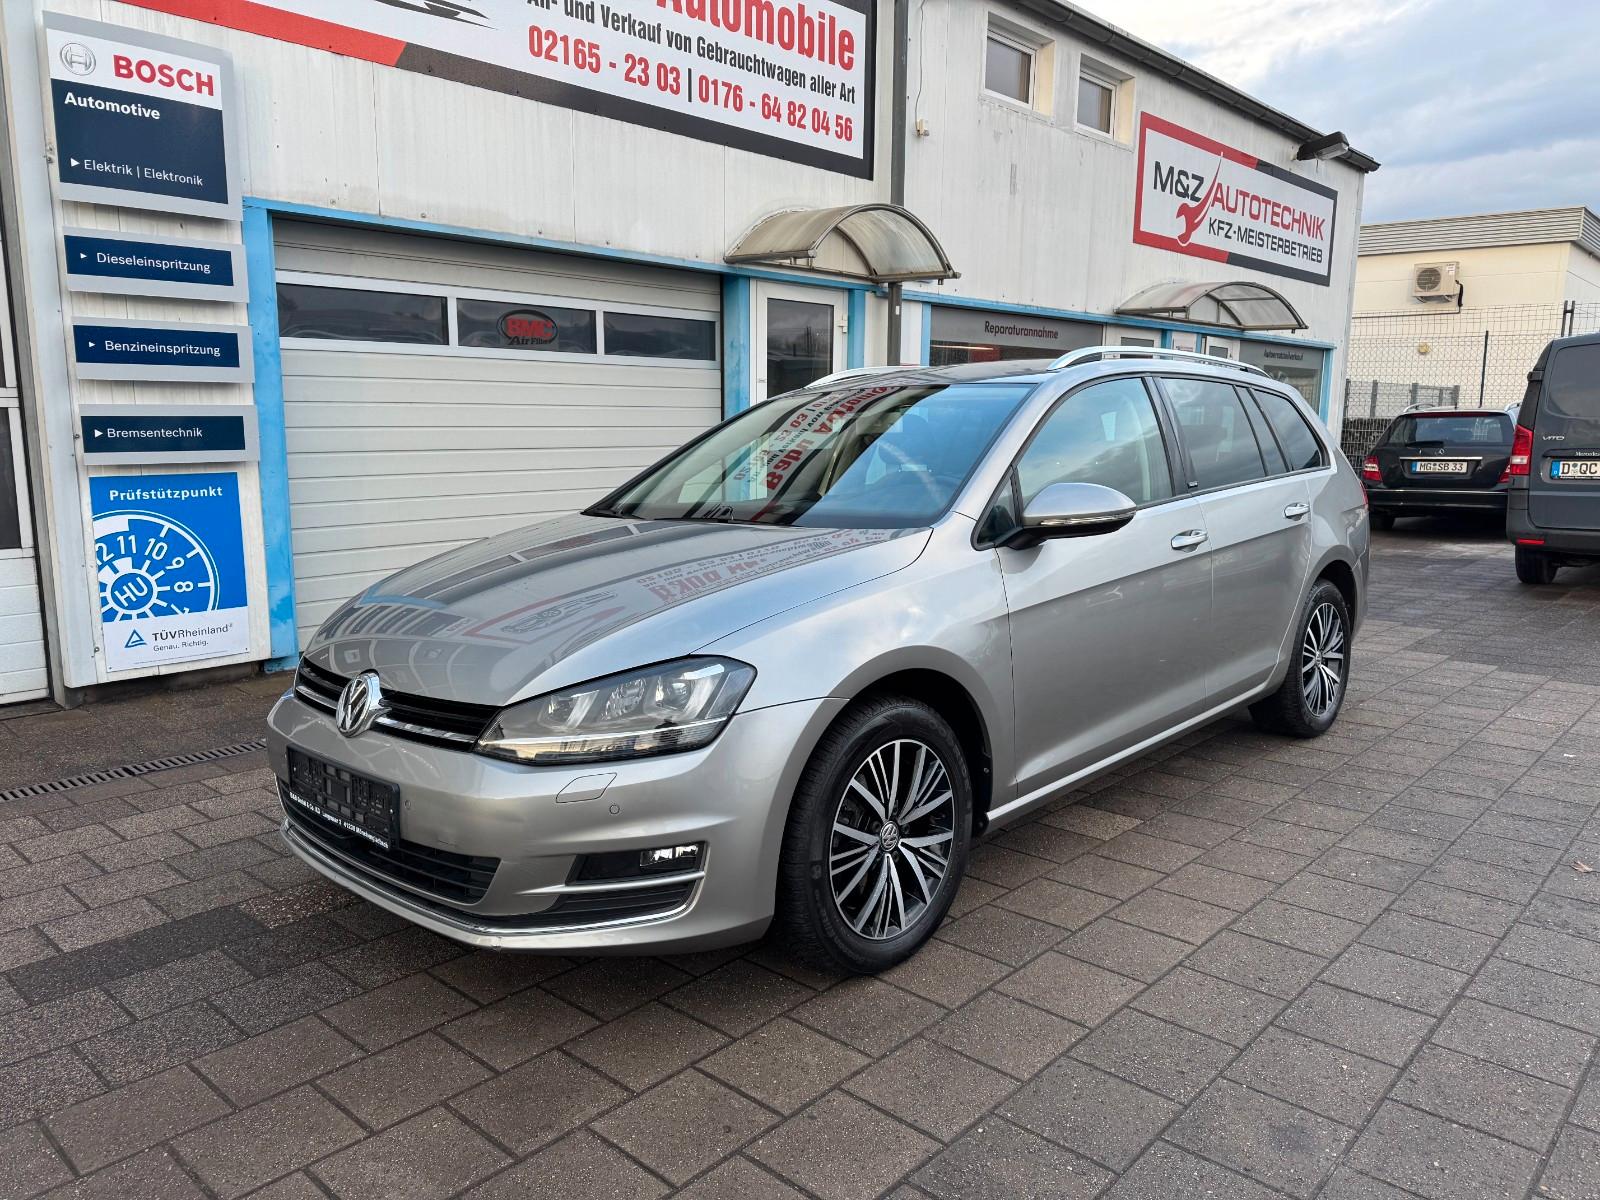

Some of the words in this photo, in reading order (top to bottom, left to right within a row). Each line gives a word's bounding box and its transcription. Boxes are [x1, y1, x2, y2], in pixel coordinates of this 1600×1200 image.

[564, 0, 594, 24] und
[600, 4, 662, 44] Verkauf
[666, 29, 691, 54] von
[697, 36, 806, 89] Gebrauchtwagen
[810, 75, 836, 98] aller
[840, 82, 855, 104] Art
[113, 54, 214, 96] BOSCH
[528, 25, 601, 74] 02165
[624, 53, 650, 87] 23
[656, 62, 681, 95] 03
[699, 74, 743, 112] 0176
[761, 93, 782, 123] 64
[787, 101, 807, 130] 82
[811, 108, 830, 135] 04
[835, 114, 853, 141] 56
[65, 92, 160, 120] Automotive
[84, 159, 133, 176] Elektrik
[144, 168, 203, 186] Elektronik
[1153, 161, 1204, 202] M&Z
[1211, 182, 1326, 241] AUTOTECHNIK
[97, 253, 211, 274] Dieseleinspritzung
[507, 318, 552, 337] BMC
[984, 321, 1058, 339] Reparaturannahme
[105, 340, 221, 357] Benzineinspritzung
[107, 427, 203, 438] Bremsentechnik
[1420, 463, 1431, 471] MG
[1438, 463, 1449, 471] SB
[1452, 463, 1463, 471] 33
[1561, 463, 1570, 474] D
[1579, 463, 1597, 475] QC
[110, 486, 223, 501] Prüfstützpunkt
[95, 542, 115, 566] 2
[116, 535, 137, 554] 11
[144, 538, 168, 560] 10
[165, 557, 185, 569] 9
[114, 576, 148, 607] HU
[174, 581, 193, 592] 8
